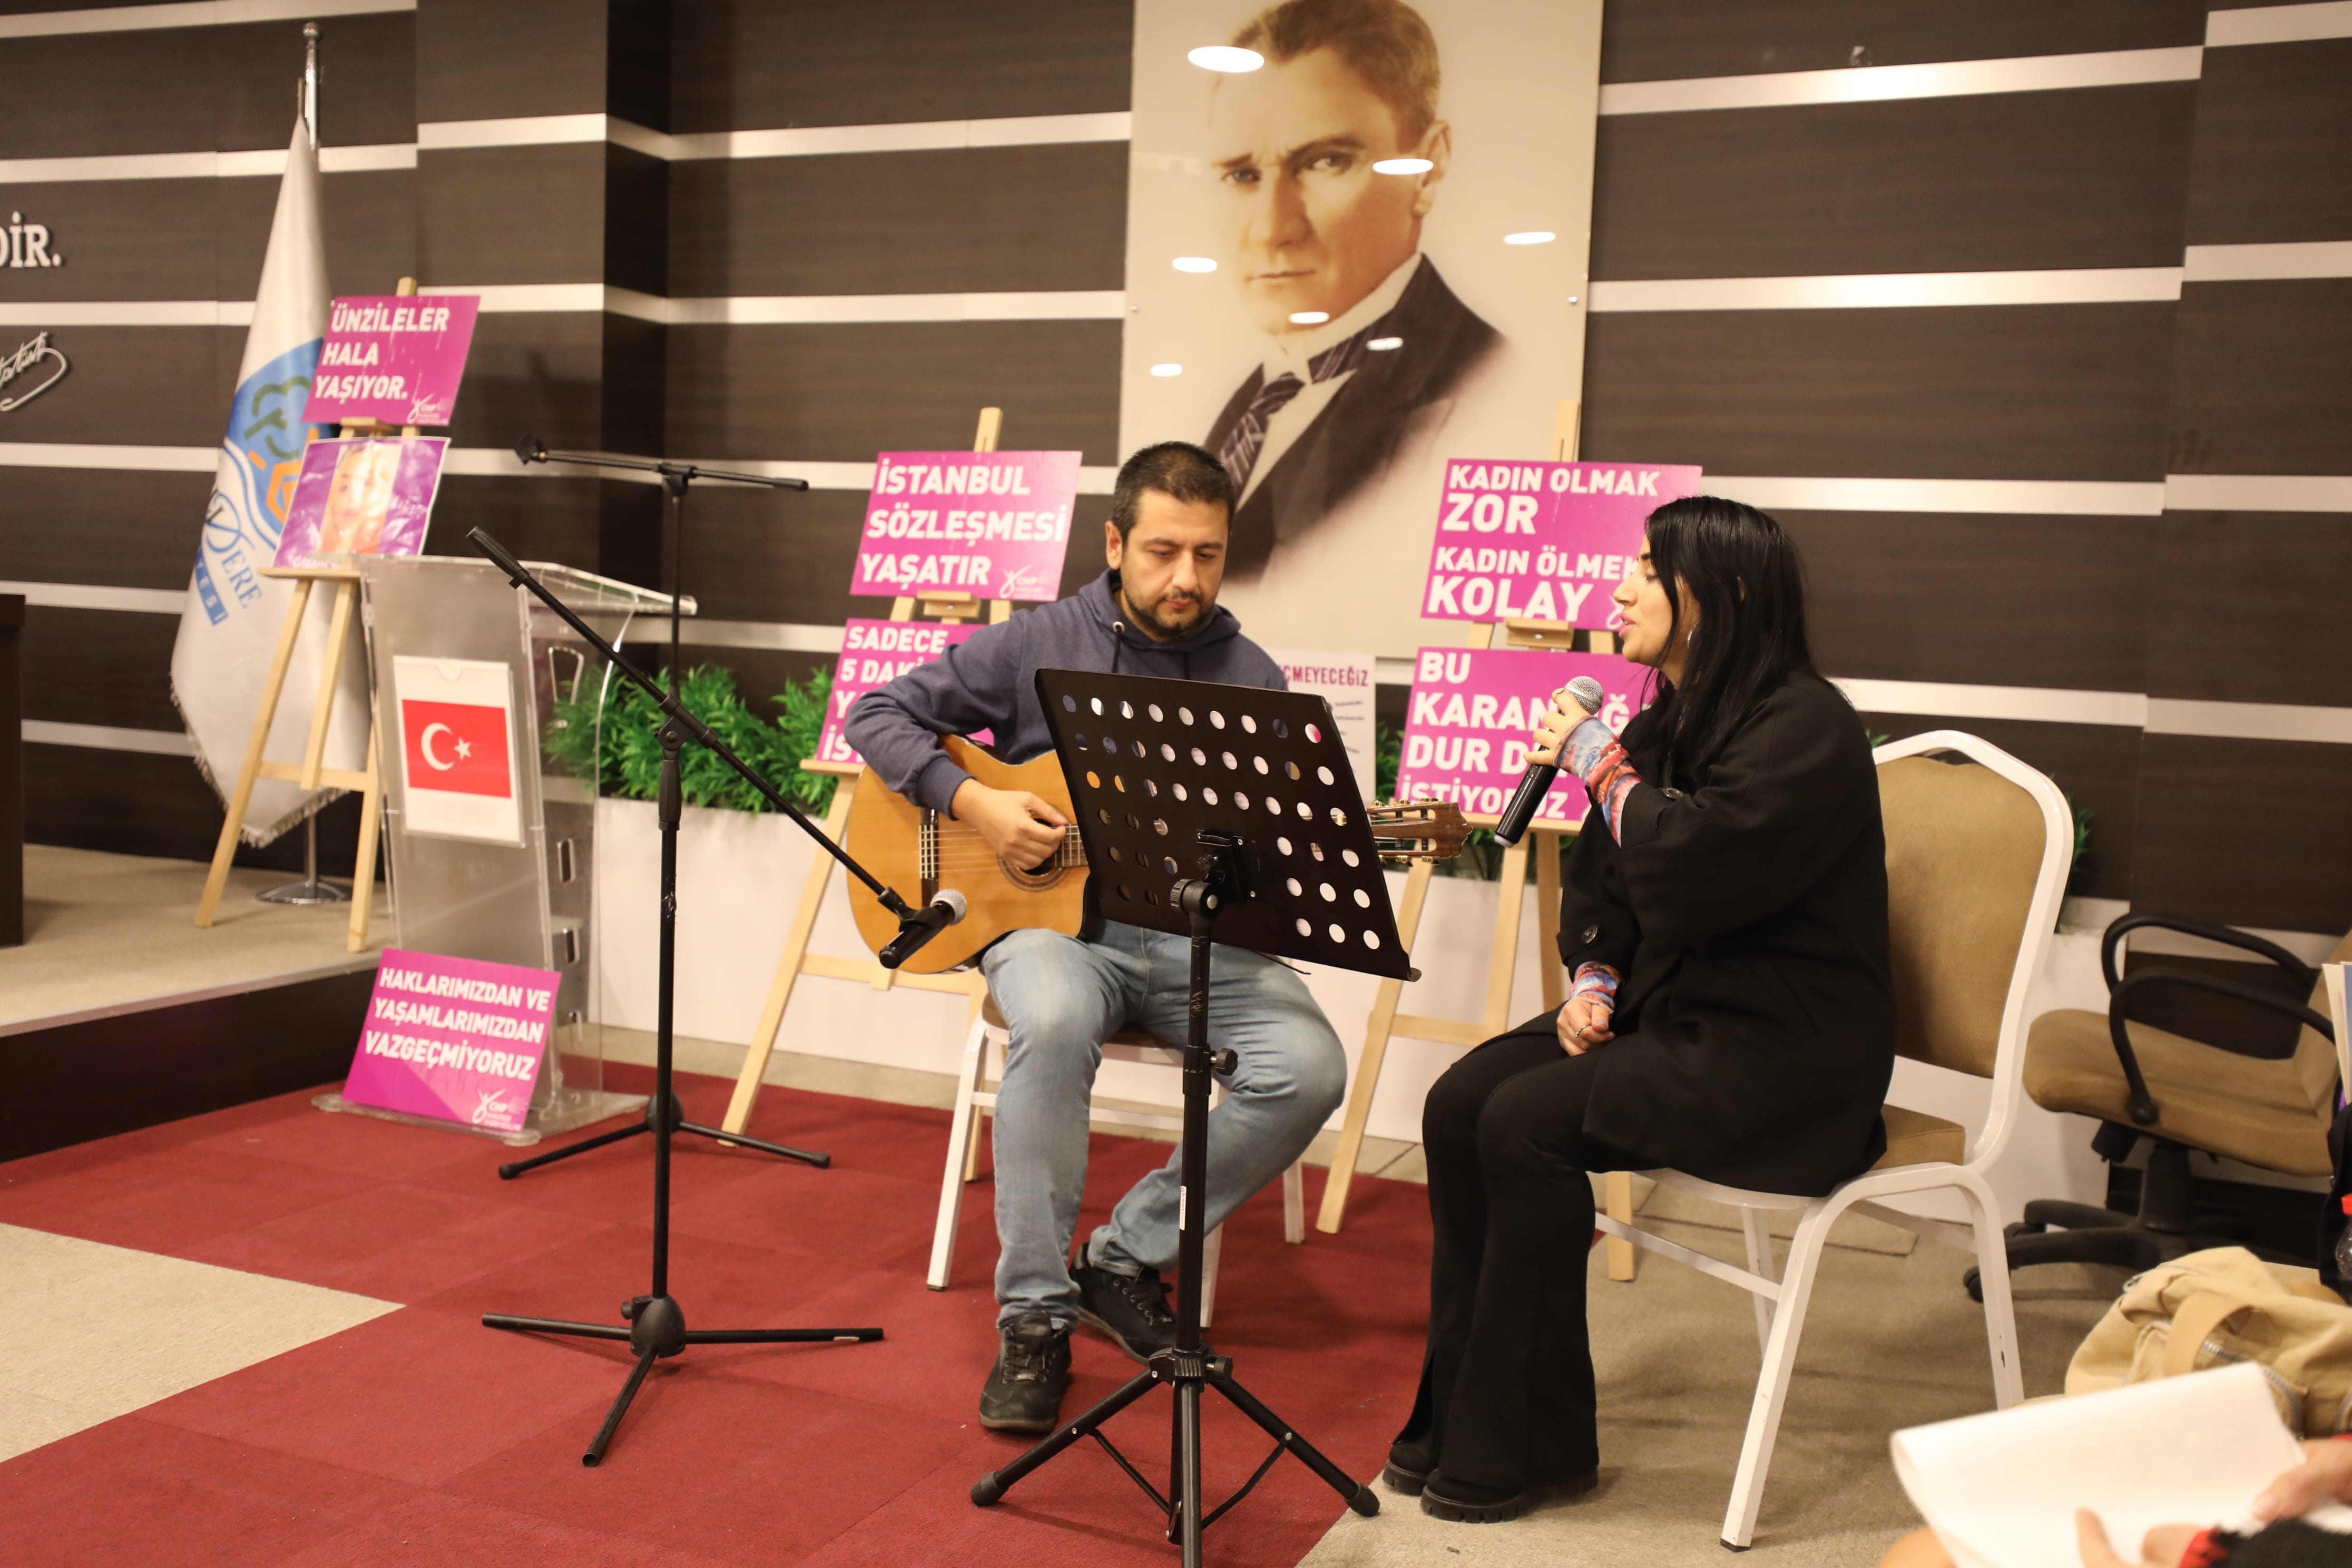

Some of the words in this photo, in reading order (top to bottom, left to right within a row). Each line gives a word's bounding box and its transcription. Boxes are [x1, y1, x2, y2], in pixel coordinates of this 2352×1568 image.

[330, 302, 450, 333] ÜNZİLELER
[321, 341, 379, 366] HALA
[315, 375, 408, 405] YAŞIYOR.
[876, 458, 1031, 495] İSTANBUL
[1448, 465, 1544, 492] KADIN
[1550, 468, 1661, 496] OLMAK
[866, 502, 1067, 547] SÖZLEŞMESİ
[1442, 493, 1540, 535] ZOR
[860, 553, 992, 590] YAŞATIR
[1435, 546, 1530, 575] KADIN
[1427, 575, 1594, 623] KOLAY
[846, 625, 948, 654] SADECE
[840, 658, 858, 682] 5
[1419, 651, 1472, 684] BU
[1406, 735, 1491, 773] DUR
[379, 967, 523, 1008] HAKLARIMIZDAN
[527, 989, 551, 1012] VE
[375, 997, 544, 1044] YAŞAMLARIMIZDAN
[365, 1030, 536, 1081] VAZGEÇMİYORUZ
